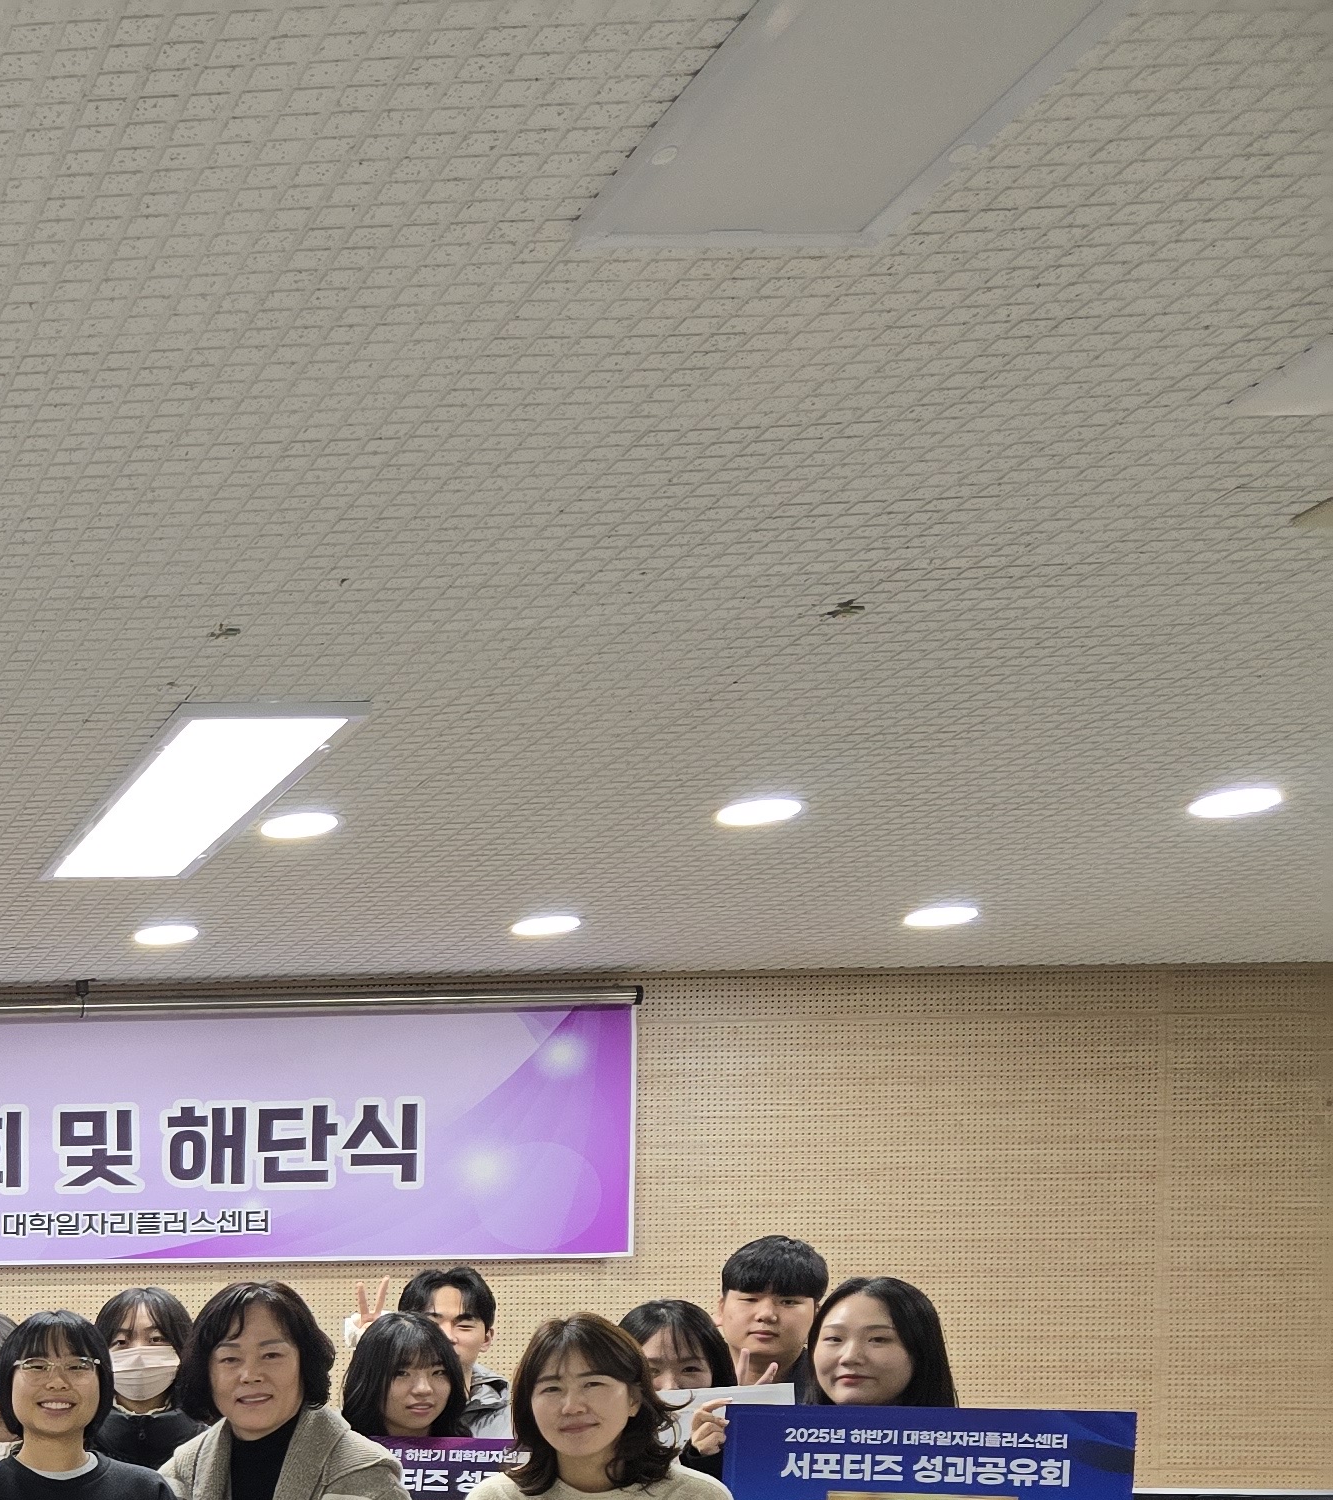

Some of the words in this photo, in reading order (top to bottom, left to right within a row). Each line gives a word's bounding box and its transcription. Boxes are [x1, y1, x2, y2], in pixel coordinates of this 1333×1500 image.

[59, 1109, 138, 1188] 및
[167, 1102, 419, 1185] 해단식
[2, 1209, 270, 1237] 대학일자리플러스센터
[785, 1428, 846, 1444] 2025년
[850, 1429, 899, 1446] 하반기
[903, 1430, 1068, 1450] 대학일자리플러스센터
[405, 1449, 445, 1463] 하반기
[781, 1452, 903, 1482] 서포터즈
[913, 1455, 1071, 1488] 성과공유회
